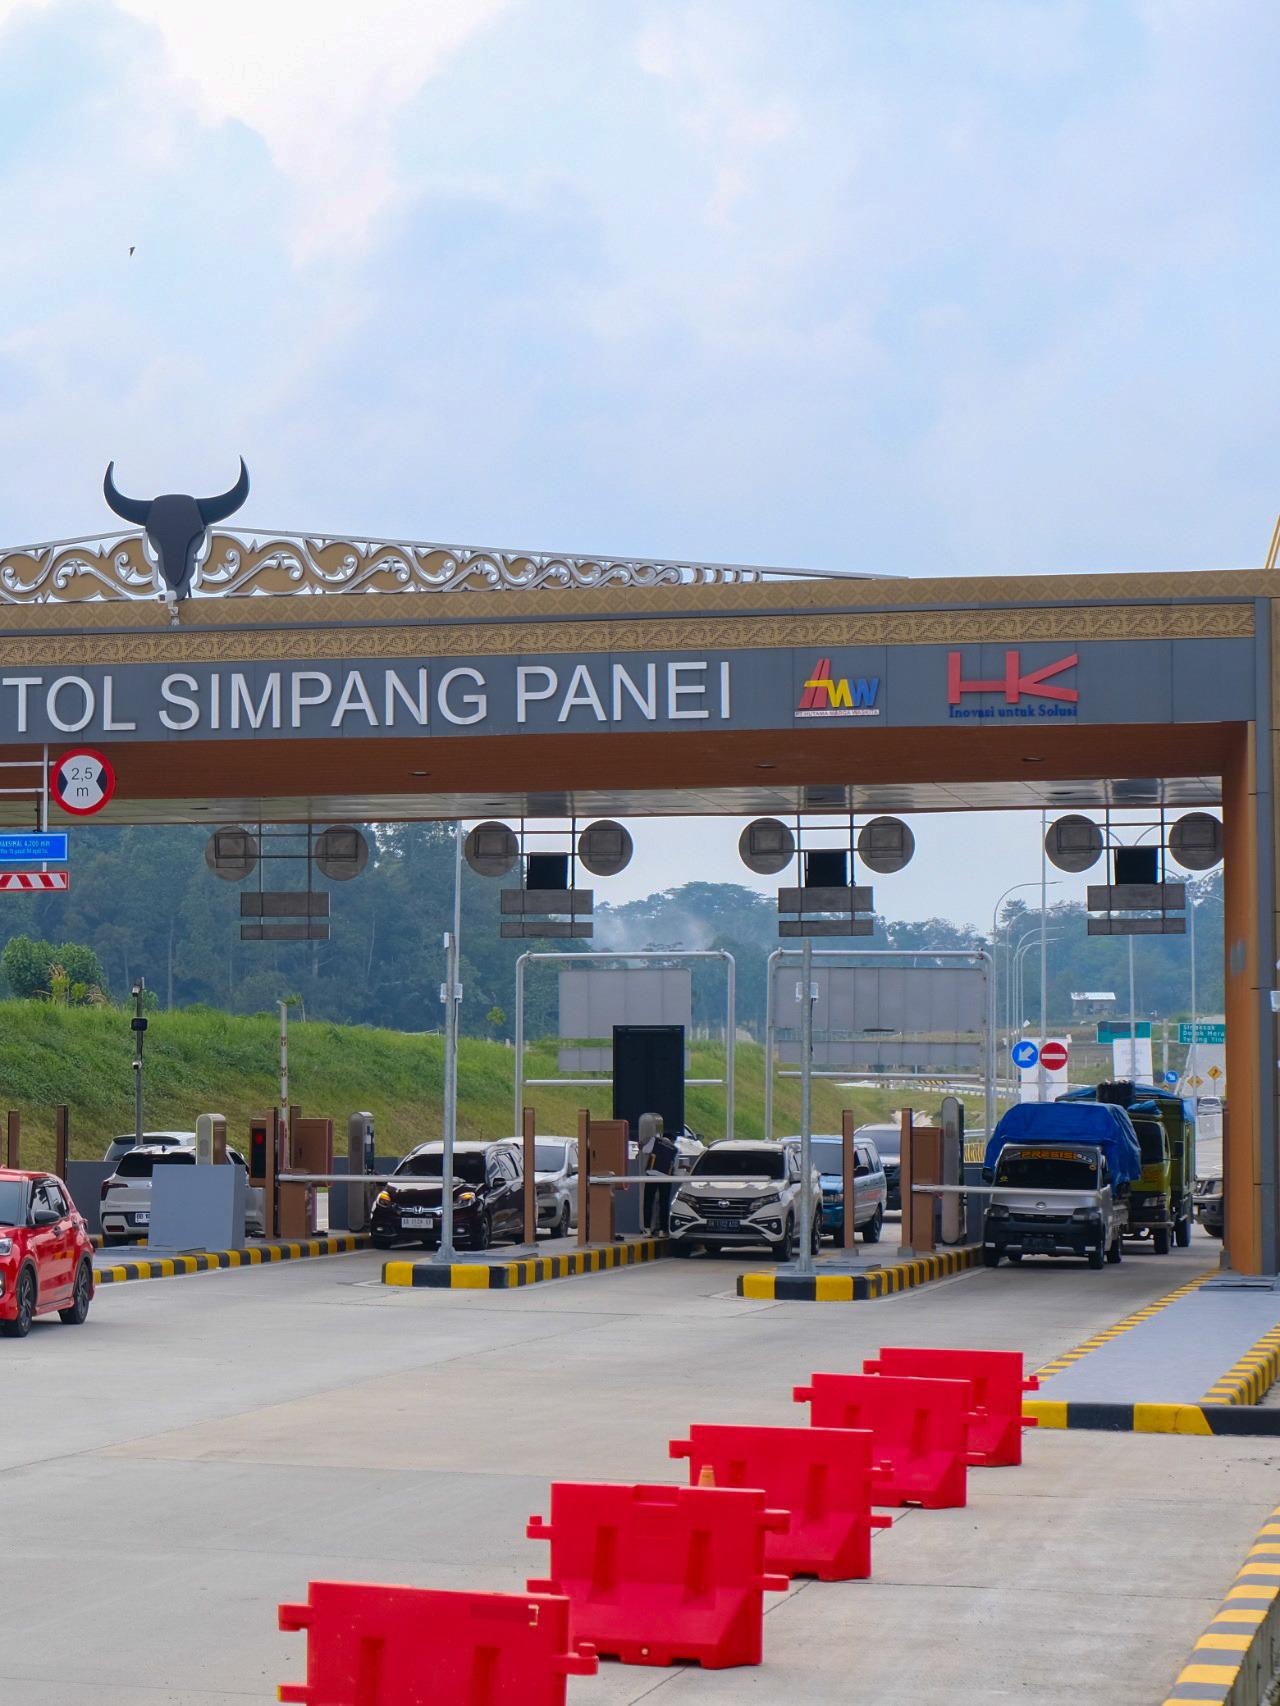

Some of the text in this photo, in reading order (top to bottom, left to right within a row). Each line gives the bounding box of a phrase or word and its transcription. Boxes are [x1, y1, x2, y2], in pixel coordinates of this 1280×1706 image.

[948, 651, 1078, 704] HK
[2, 675, 136, 732] TOL
[158, 667, 487, 731] SIMPANG
[516, 661, 730, 723] PANEI
[949, 703, 1078, 718] Inovasi untuk Solusi
[71, 767, 93, 782] 2,5
[76, 786, 89, 797] m
